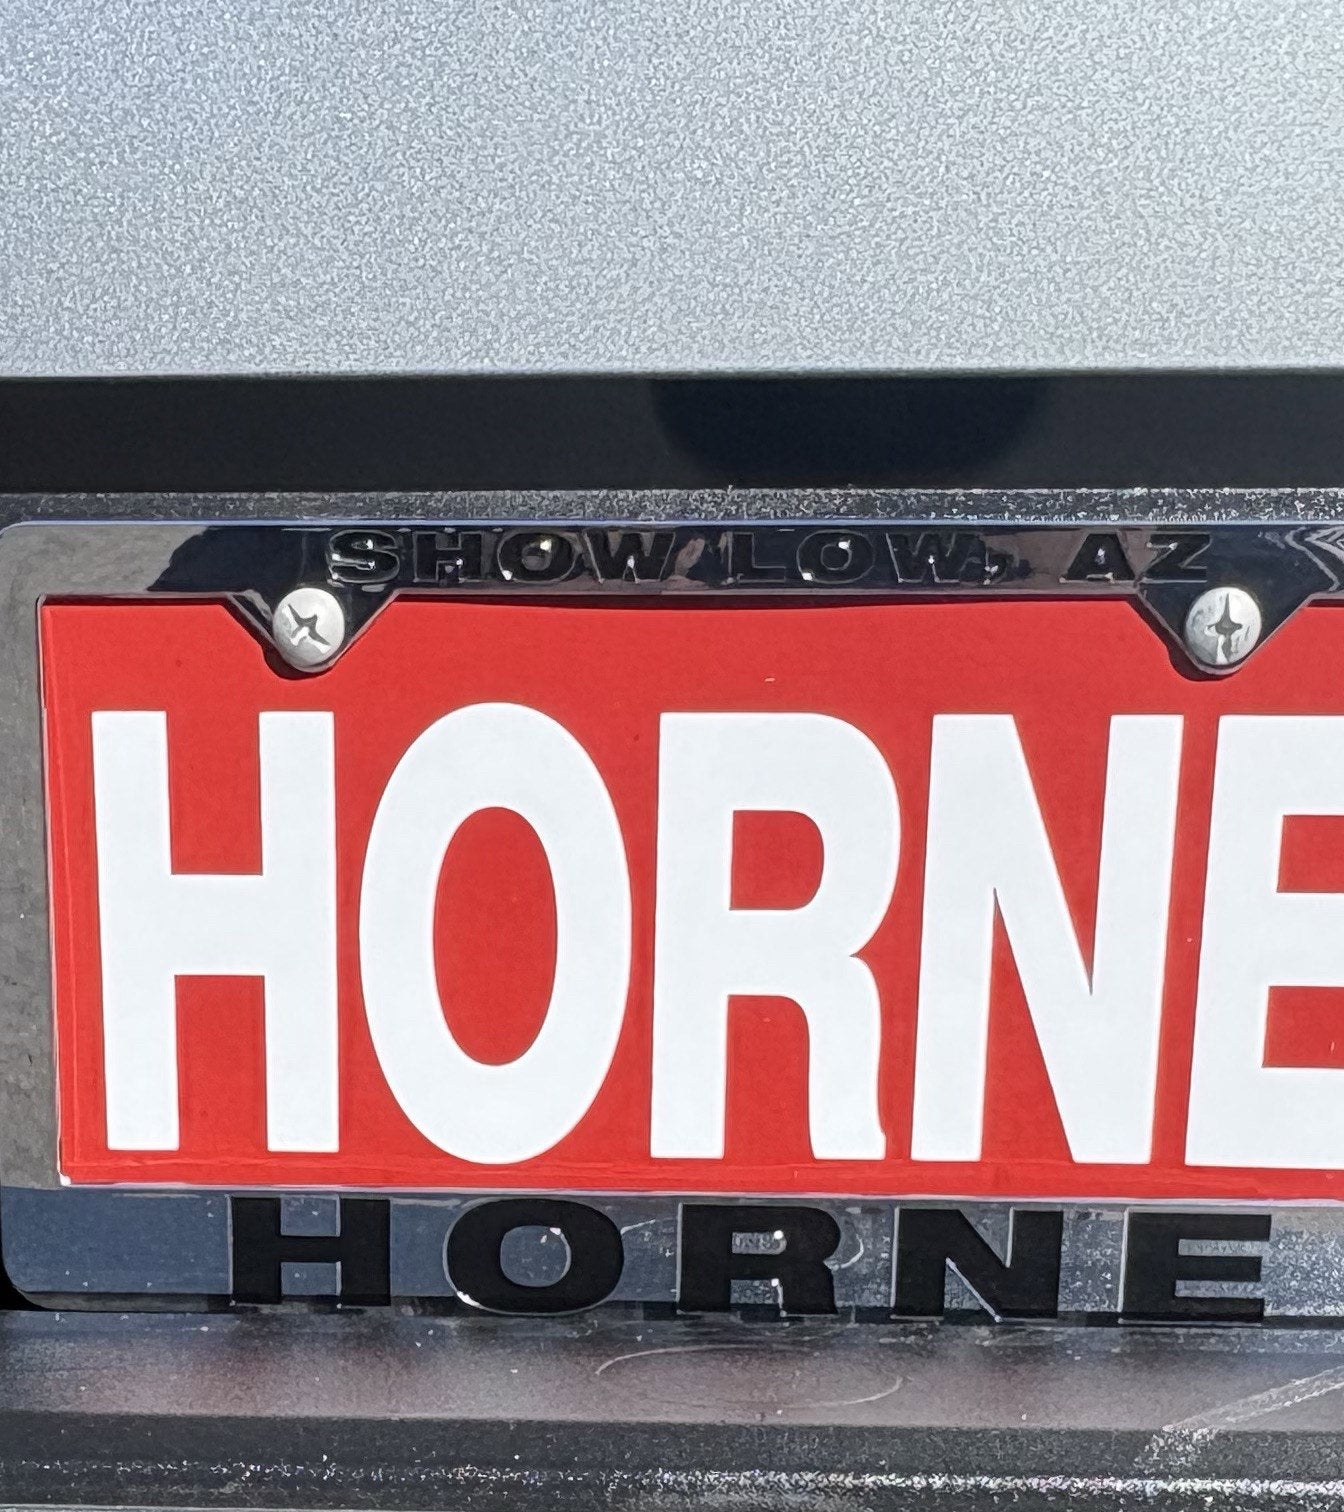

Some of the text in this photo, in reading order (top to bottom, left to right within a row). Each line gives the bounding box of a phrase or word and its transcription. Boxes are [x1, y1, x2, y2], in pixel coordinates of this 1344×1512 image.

[327, 528, 676, 584] SHOW
[1058, 531, 1212, 584] AZ
[228, 1194, 1273, 1322] HORNE
